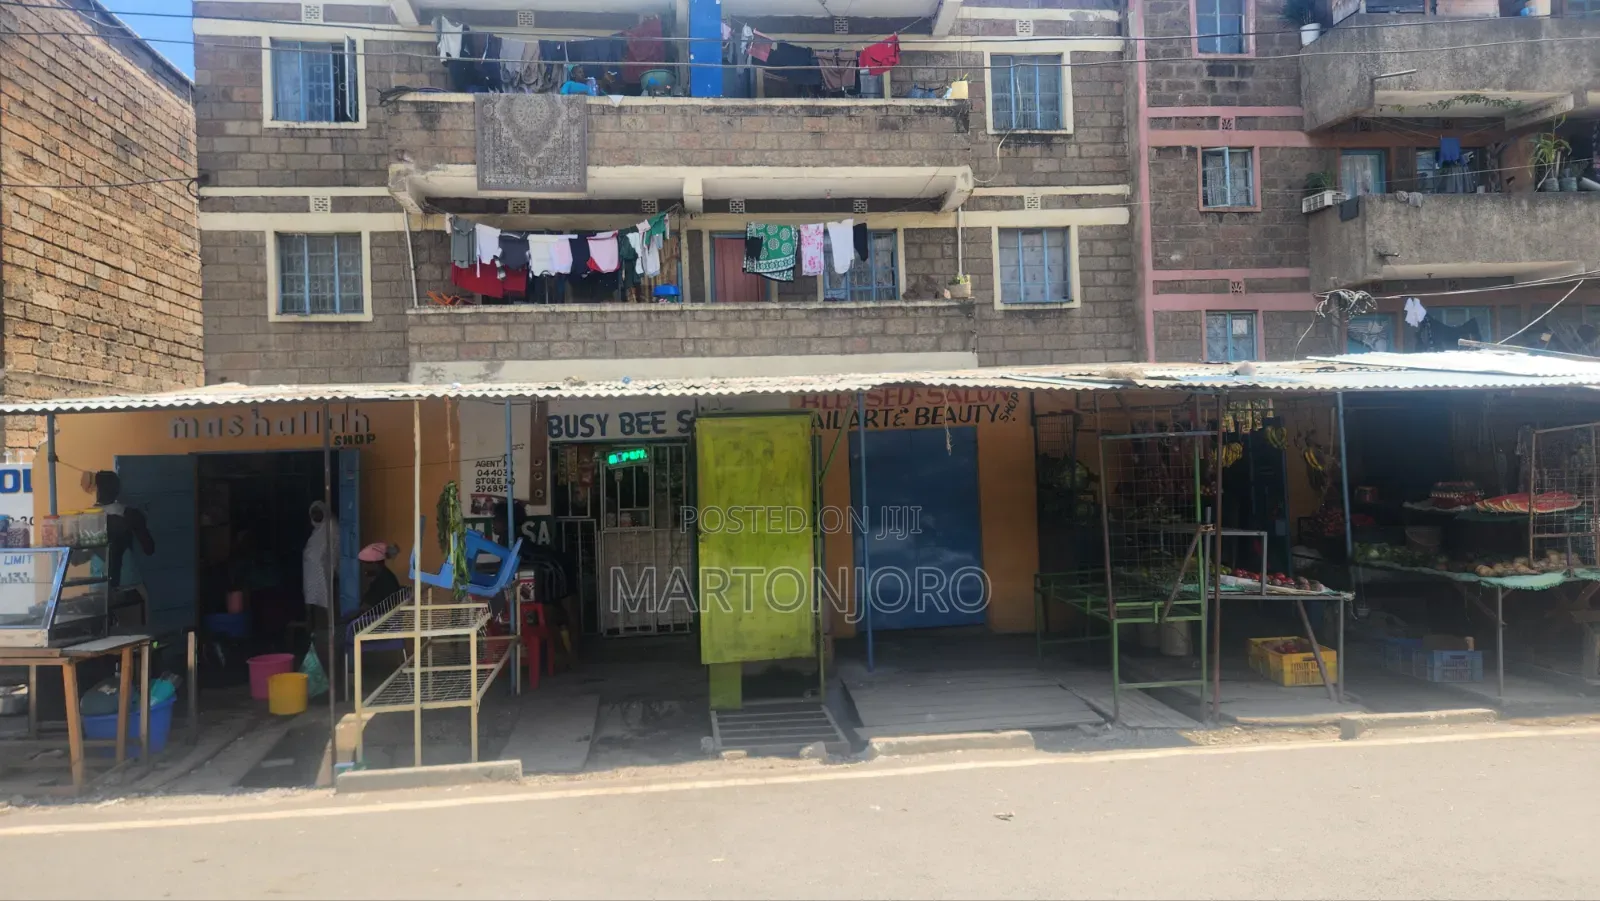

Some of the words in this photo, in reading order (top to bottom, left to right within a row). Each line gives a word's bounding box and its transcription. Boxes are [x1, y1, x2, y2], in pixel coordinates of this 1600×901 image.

[800, 387, 914, 409] BLESED
[811, 410, 842, 430] AIL
[849, 407, 894, 430] ART
[914, 403, 999, 426] BEAUTY
[998, 391, 1019, 422] SHOP
[547, 413, 609, 438] BUSY
[619, 411, 667, 436] BEE
[676, 409, 693, 434] S
[334, 433, 376, 445] SHOP
[474, 460, 500, 468] AGENT
[476, 469, 514, 477] 04403
[475, 477, 502, 485] STORE
[4, 554, 33, 565] LIMIT
